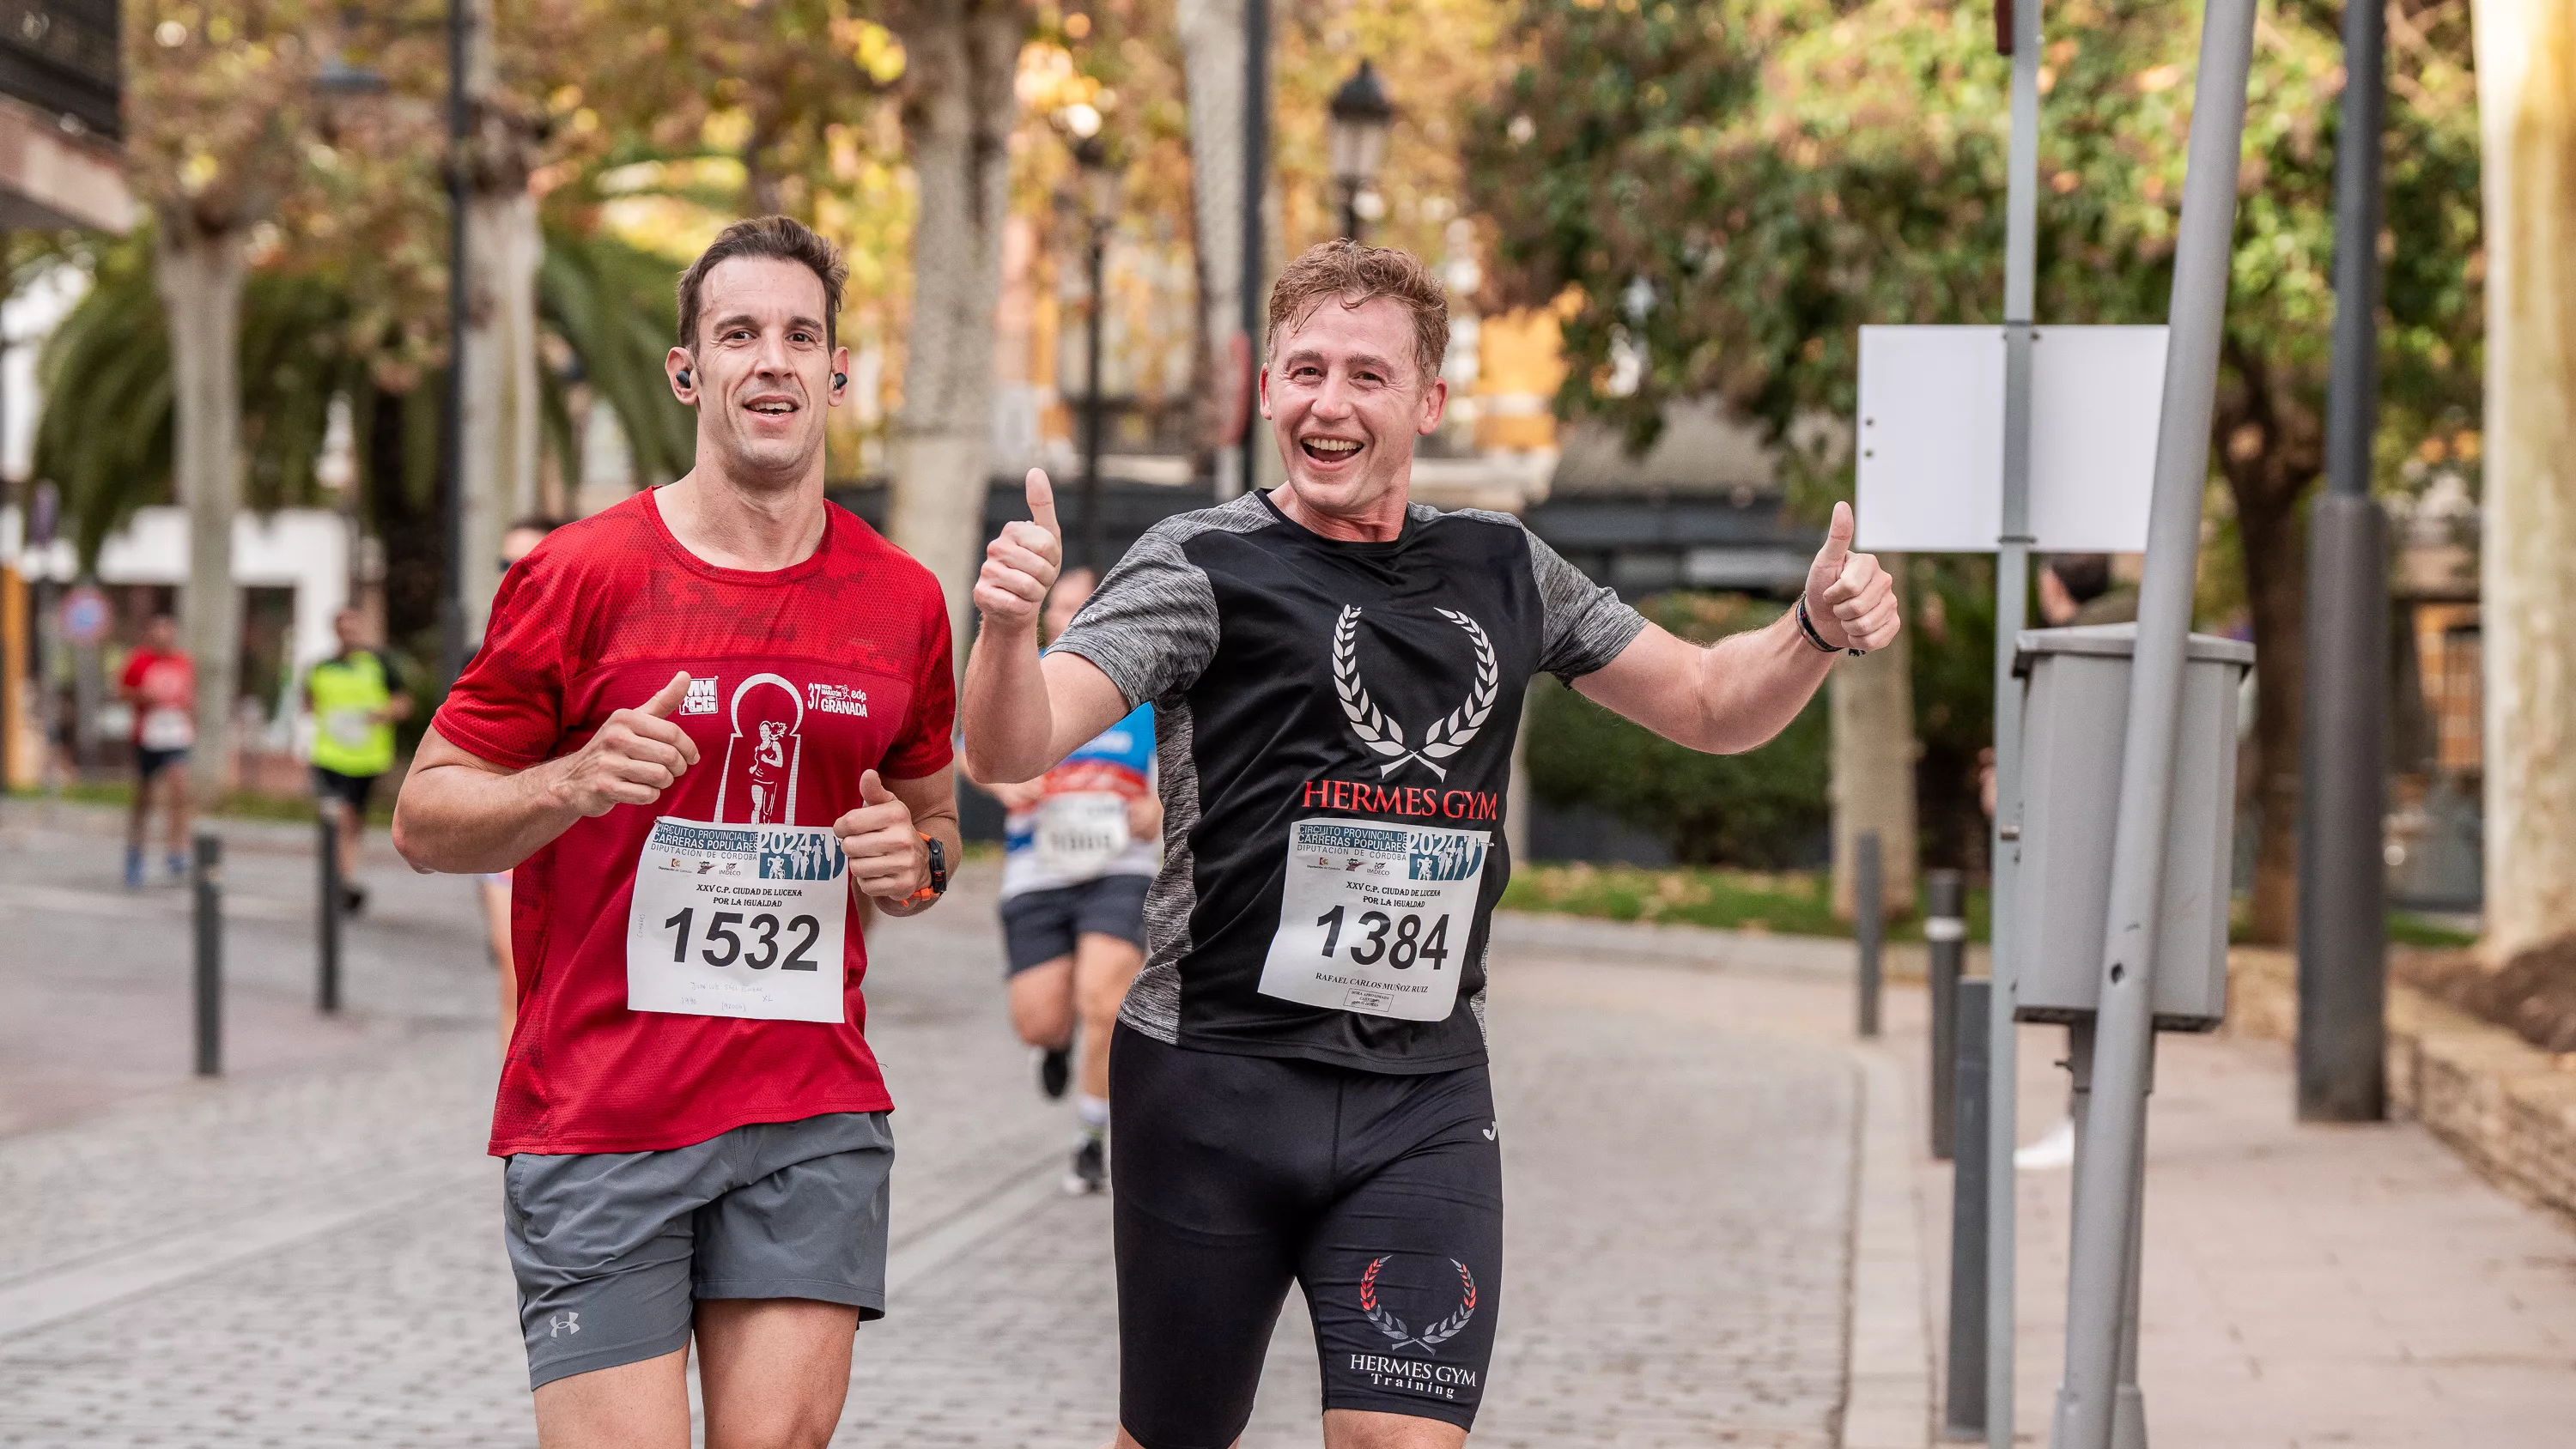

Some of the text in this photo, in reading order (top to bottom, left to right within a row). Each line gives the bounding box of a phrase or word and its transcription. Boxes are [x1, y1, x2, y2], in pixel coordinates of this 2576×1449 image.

[808, 682, 821, 710] 37
[851, 688, 866, 703] edp
[821, 698, 867, 718] GRANADA
[1302, 779, 1498, 821] HERMES GYM
[657, 823, 758, 841] CIRCUITO PROVINCIAL DE
[1299, 825, 1407, 841] CIRCUITO PROVINCIAL DE
[651, 843, 702, 858] DIPUTACIÓN
[721, 851, 757, 860] CÓRDOBA
[653, 833, 757, 852] CARRERAS POPULARES
[759, 832, 812, 855] 2024
[1298, 834, 1406, 852] CARRERAS POPULARES
[1410, 832, 1457, 857] 2024
[1297, 844, 1349, 855] DIPUTACIÓN
[1370, 851, 1406, 861] CÓRDOBA
[696, 884, 715, 893] XXV
[732, 887, 761, 895] CIUDAD
[1346, 881, 1364, 890] XXV
[1365, 884, 1380, 894] C.P.
[1382, 887, 1410, 896] CIUDAD
[1363, 895, 1378, 904] POR
[1381, 898, 1392, 906] LA
[665, 907, 820, 972] 1532
[1316, 905, 1449, 970] 1384
[1315, 972, 1348, 985] RAFAEL
[1349, 978, 1382, 989] CARLOS
[1382, 983, 1411, 992] MUÑOZ
[1350, 1354, 1476, 1387] HERMES GYM
[1371, 1373, 1455, 1399] Training
